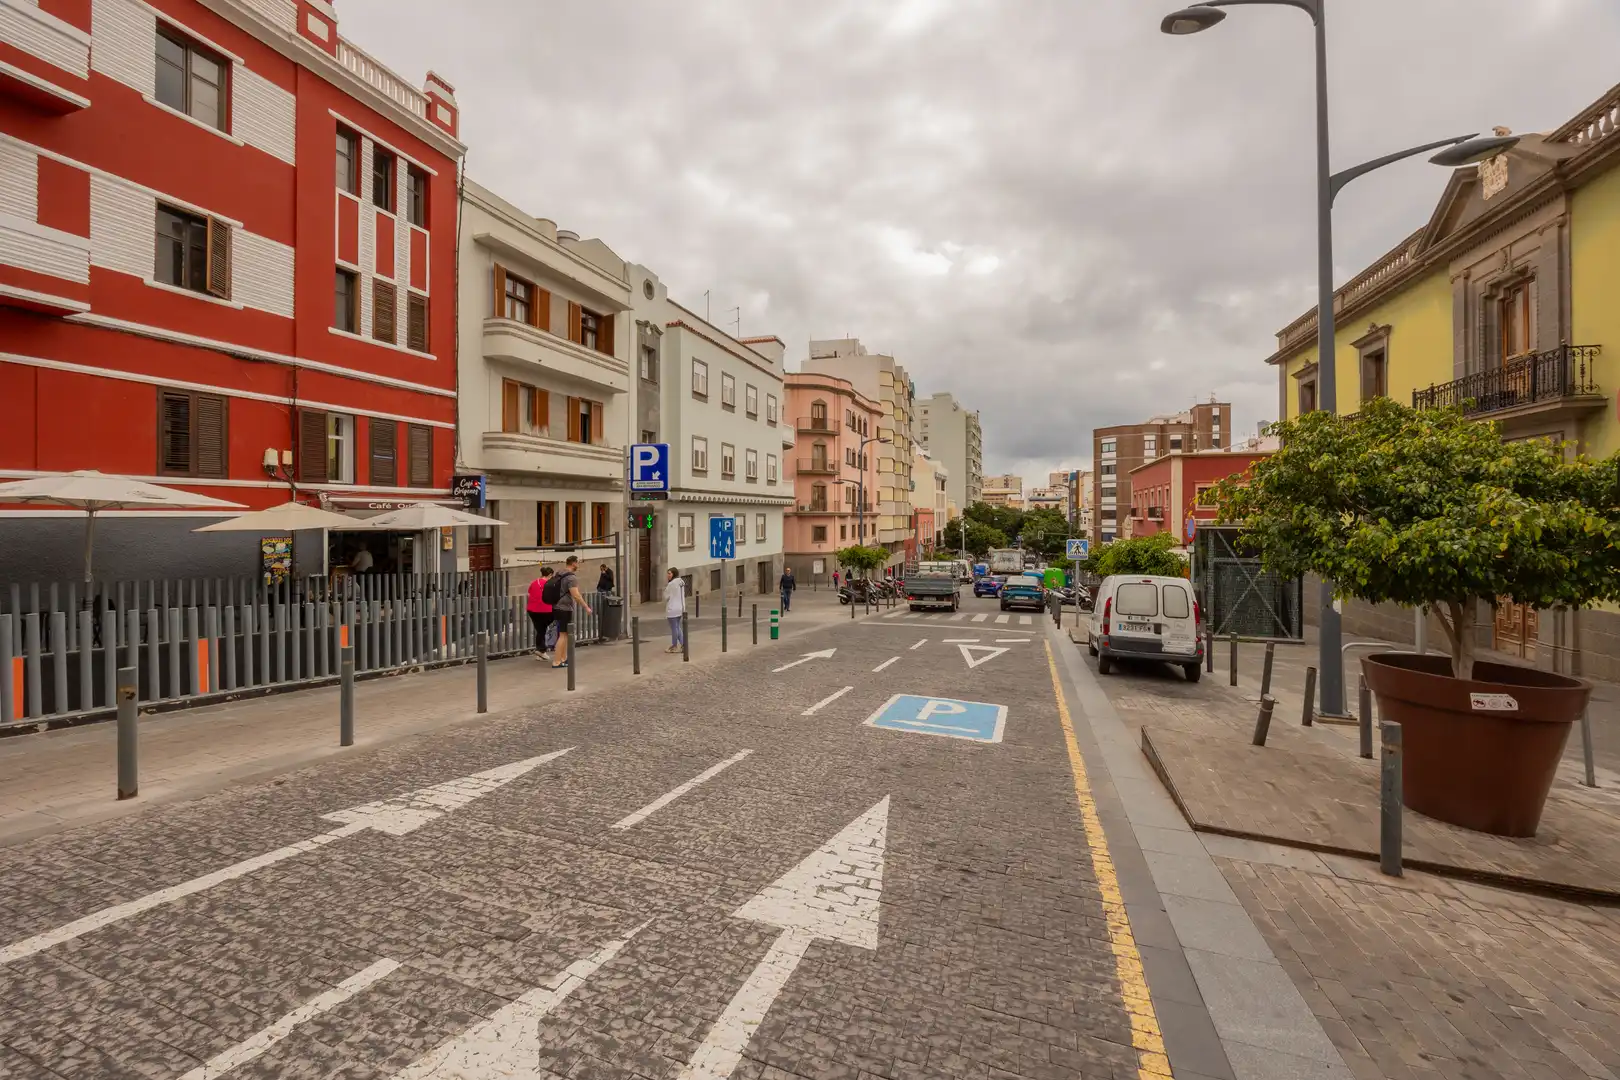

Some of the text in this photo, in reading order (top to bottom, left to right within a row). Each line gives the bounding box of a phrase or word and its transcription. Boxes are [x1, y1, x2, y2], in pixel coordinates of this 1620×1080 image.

[633, 445, 660, 481] P
[724, 521, 731, 530] P
[915, 699, 967, 720] P
